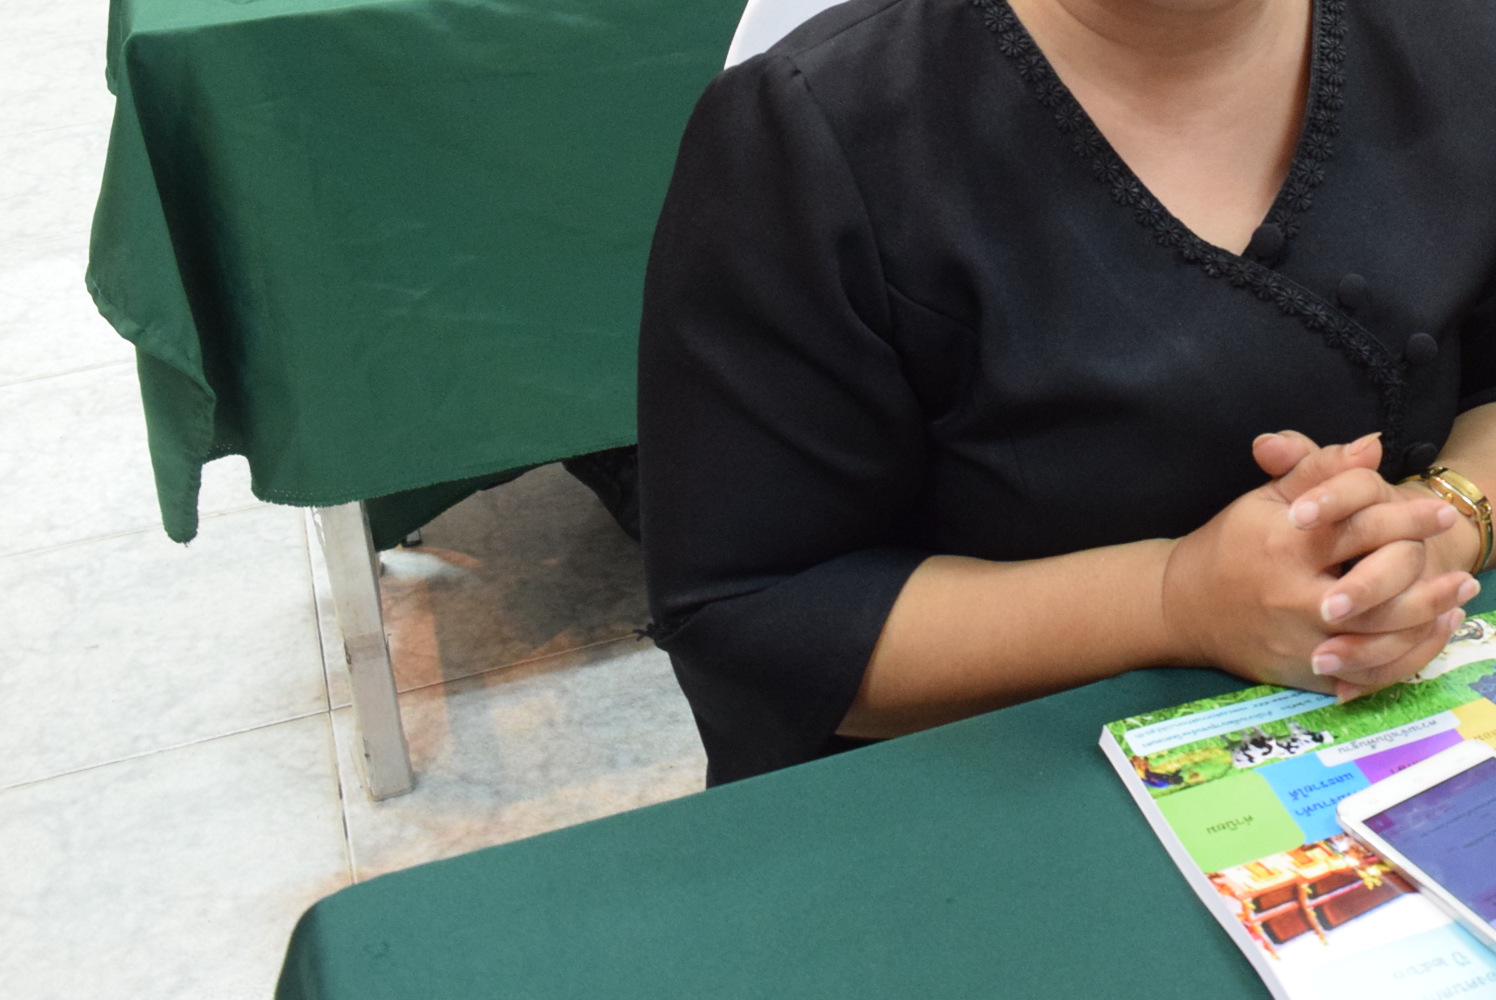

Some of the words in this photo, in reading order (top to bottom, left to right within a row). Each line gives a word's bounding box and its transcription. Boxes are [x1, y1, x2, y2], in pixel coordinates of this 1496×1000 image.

[1288, 772, 1354, 802] และรายได้
[1206, 814, 1254, 834] ค่านิยม
